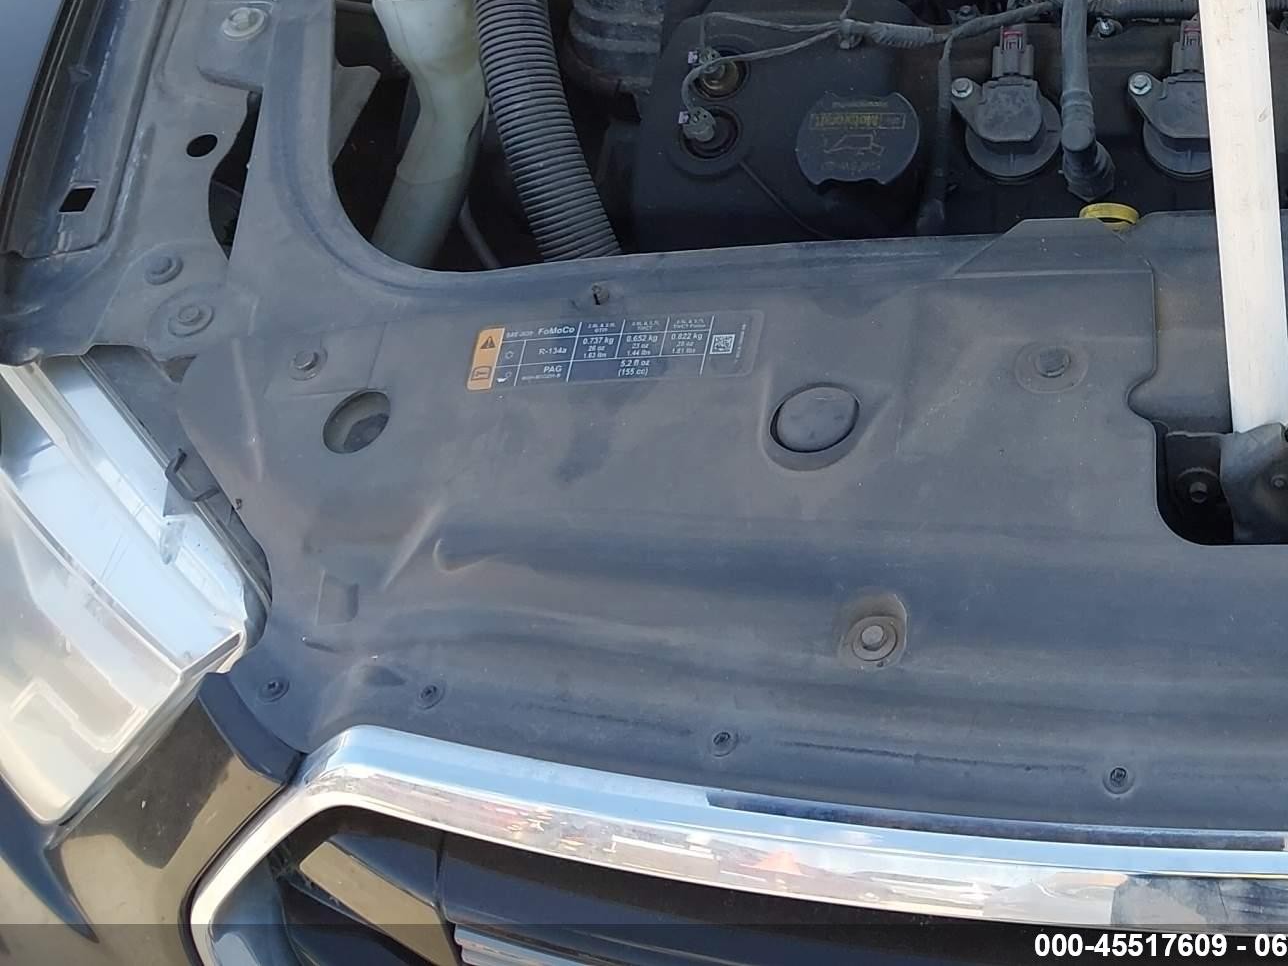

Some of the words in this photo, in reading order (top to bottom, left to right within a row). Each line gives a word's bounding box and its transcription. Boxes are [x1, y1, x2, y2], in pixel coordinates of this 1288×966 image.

[538, 326, 575, 335] FoMoCo
[604, 336, 614, 345] kg
[648, 335, 658, 343] kg
[692, 333, 703, 341] kg
[538, 347, 568, 355] R-134a
[543, 365, 562, 373] PAG
